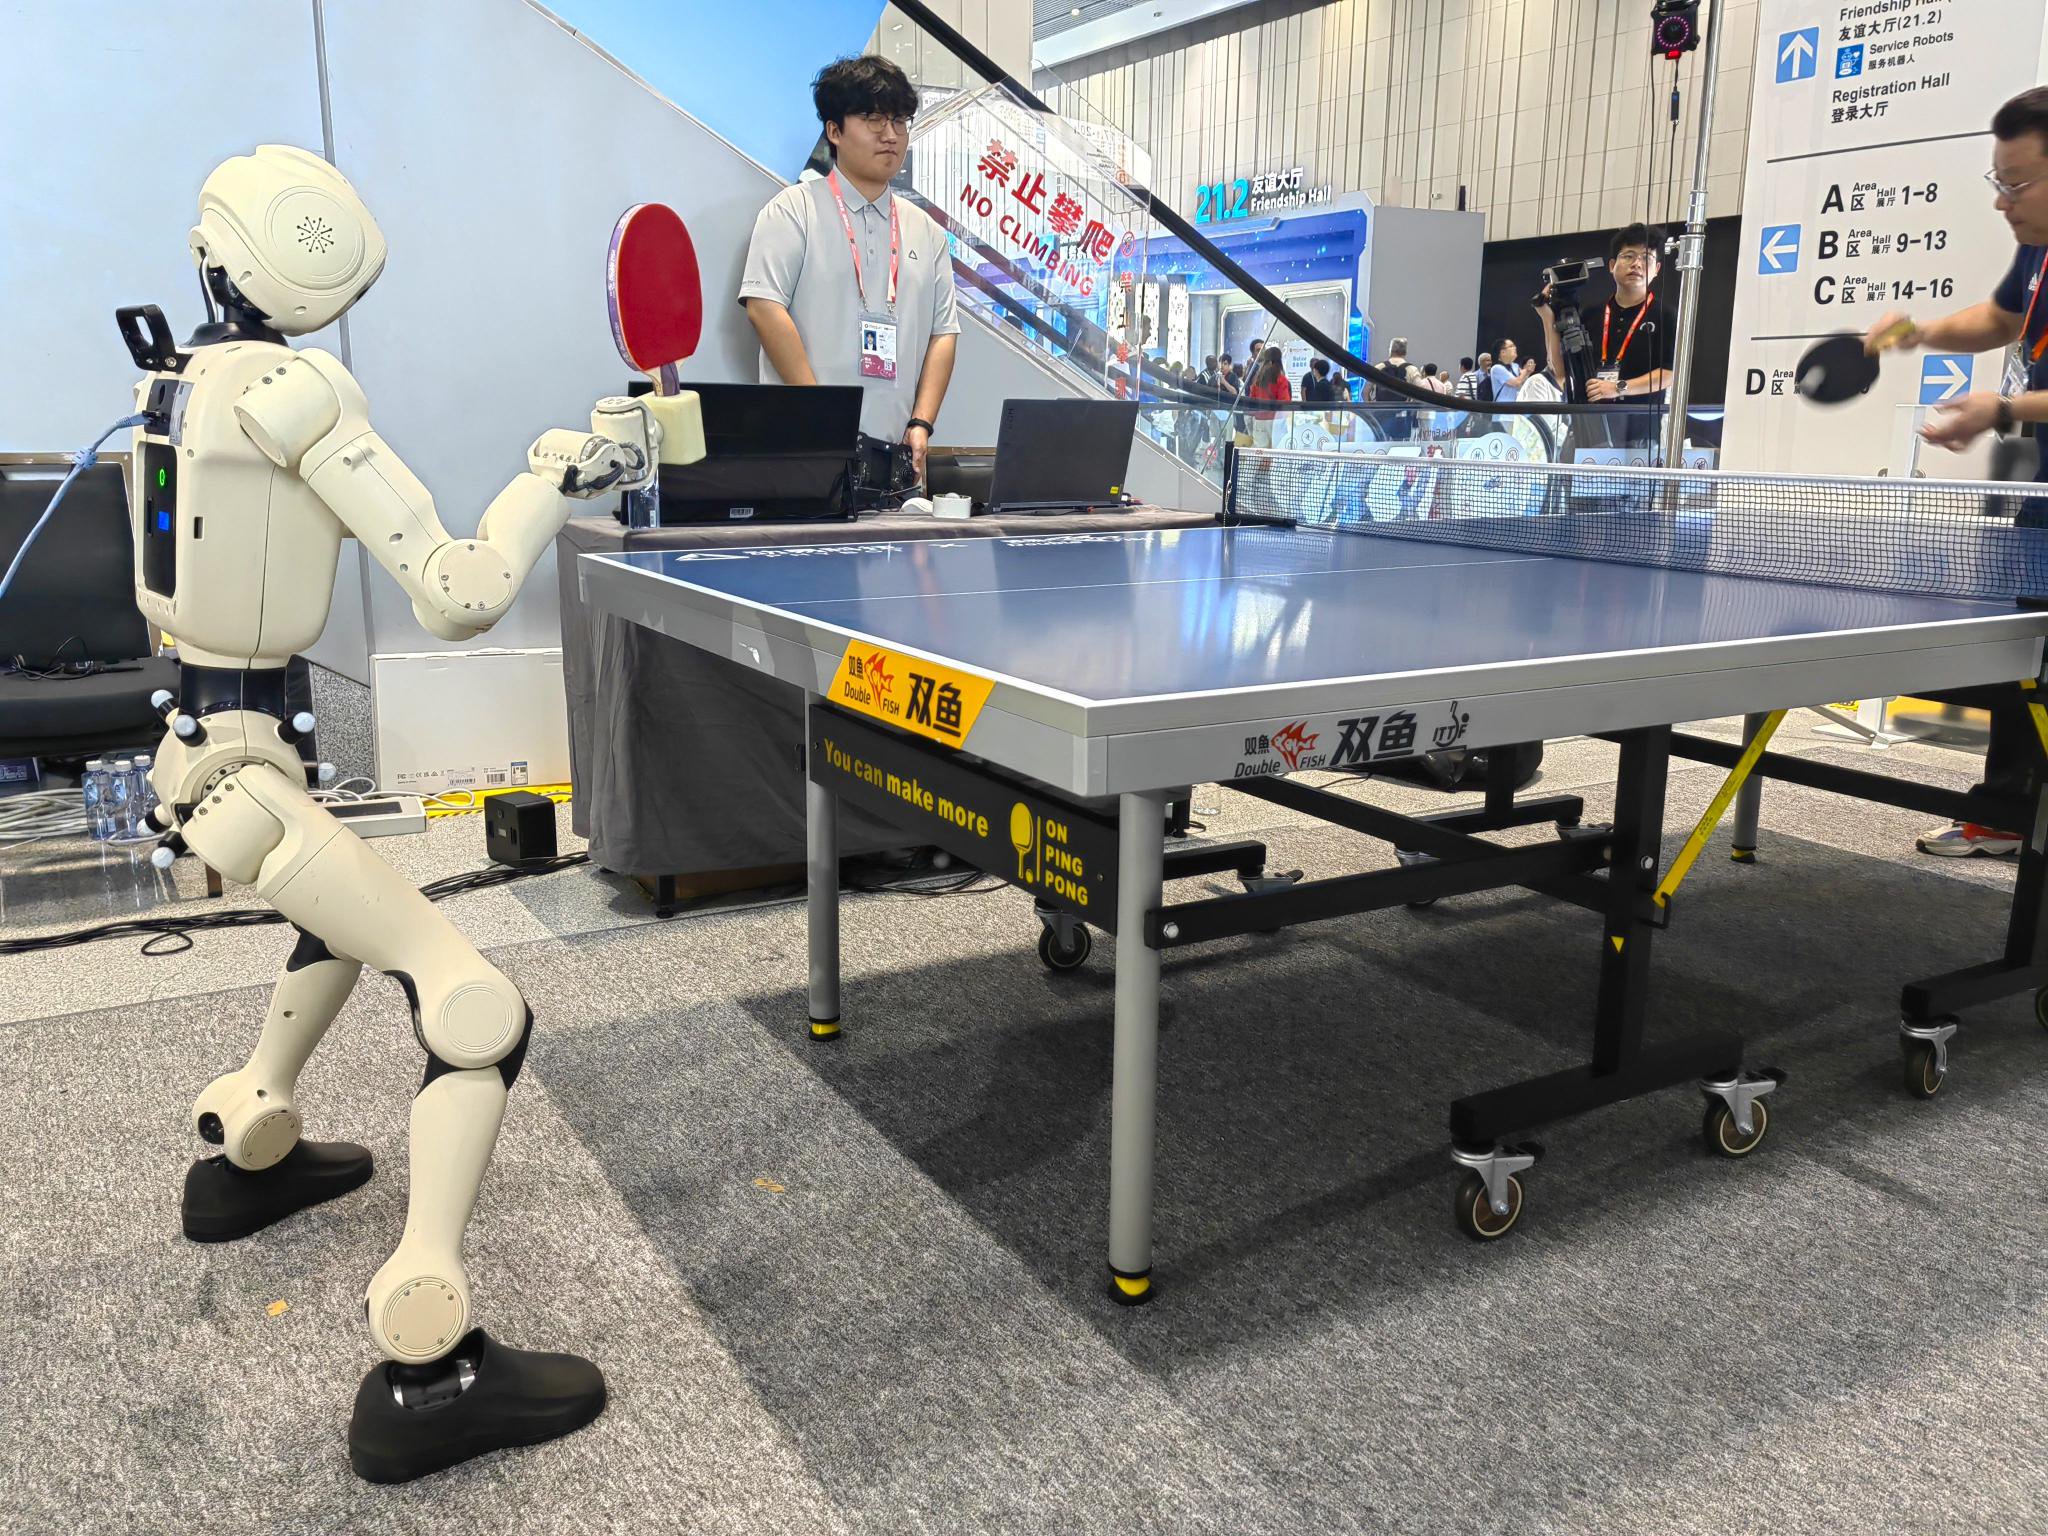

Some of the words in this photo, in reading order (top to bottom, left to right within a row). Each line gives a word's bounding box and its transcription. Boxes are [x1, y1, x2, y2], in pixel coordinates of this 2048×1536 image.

[1839, 9, 1942, 41] 友谊大厅(21.2)
[1840, 0, 1911, 21] Friendship
[1869, 41, 1910, 55] Service
[1912, 32, 1954, 47] Robots
[1868, 54, 1916, 70] 服务机器人
[1832, 79, 1917, 104] Registration
[1921, 72, 1951, 90] Hall
[1831, 101, 1889, 124] 登录大厅
[1252, 167, 1304, 195] 友谊大厅
[976, 138, 1116, 267] 禁止攀爬
[1195, 178, 1249, 225] 21.2
[1251, 191, 1307, 212] Friendship
[1308, 185, 1332, 204] Hall
[1820, 184, 1844, 214] A
[1853, 182, 1877, 192] Area
[1877, 187, 1896, 198] Hall
[1902, 182, 1938, 205] 1-8
[1851, 193, 1865, 211] 区
[1876, 197, 1896, 207] 展厅
[960, 183, 993, 217] NO
[999, 214, 1095, 298] CLIMBING
[1818, 230, 1839, 259] B
[1848, 229, 1872, 239] Area
[1872, 235, 1891, 245] Hall
[1896, 229, 1947, 253] 9-13
[1846, 240, 1860, 257] 区
[1871, 245, 1891, 255] 展厅
[1814, 275, 1836, 305] C
[1843, 275, 1867, 285] Area
[1867, 282, 1886, 292] Hall
[1891, 277, 1954, 300] 14-16
[1841, 287, 1856, 304] 区
[1866, 291, 1886, 301] 展厅
[1745, 368, 1766, 395] D
[1772, 369, 1794, 378] Area
[1771, 380, 1784, 395] 区
[844, 680, 871, 705] Double
[883, 698, 900, 716] FISH
[905, 672, 963, 738] 双鱼
[1329, 709, 1417, 767] 双鱼
[1432, 723, 1467, 742] ITTF
[1234, 759, 1280, 778] Double
[1299, 754, 1326, 769] FISH
[824, 738, 851, 772] You
[854, 758, 883, 788] can
[887, 773, 934, 812] make
[938, 796, 989, 838] more
[1045, 819, 1068, 844] ON
[1045, 844, 1084, 877] PING
[1045, 870, 1088, 906] PONG
